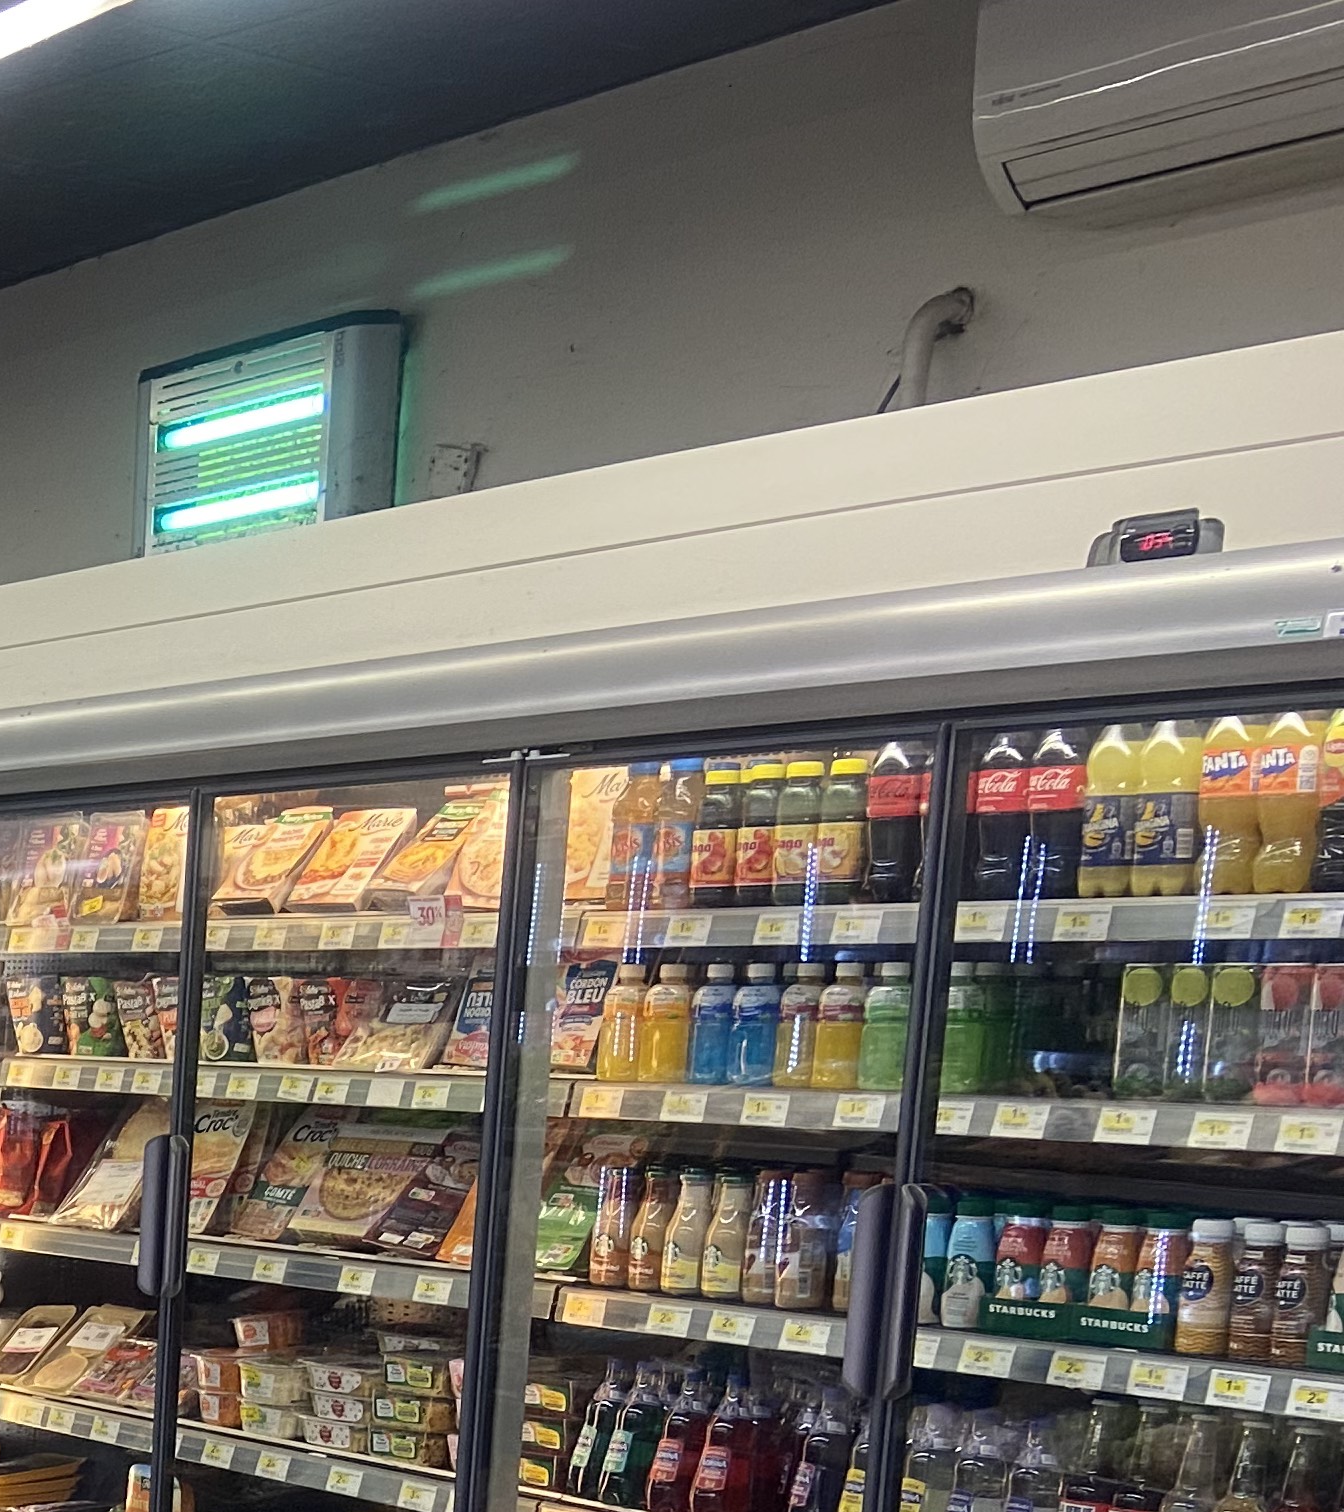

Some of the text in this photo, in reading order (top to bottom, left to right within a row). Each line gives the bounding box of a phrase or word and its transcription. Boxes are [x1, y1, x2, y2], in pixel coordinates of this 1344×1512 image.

[1203, 751, 1248, 773] FANTA
[985, 772, 1022, 792] Cola
[1036, 768, 1074, 789] Cola
[355, 813, 405, 831] Marie
[418, 905, 443, 926] 30%
[570, 978, 609, 990] CORDON
[567, 988, 605, 1005] BLEU
[329, 1153, 370, 1170] QUICHE
[1233, 1285, 1256, 1294] ATTE
[1276, 1289, 1299, 1299] ATTE
[988, 1303, 1056, 1319] STARBUCKS
[1080, 1316, 1149, 1334] STARBUCKS
